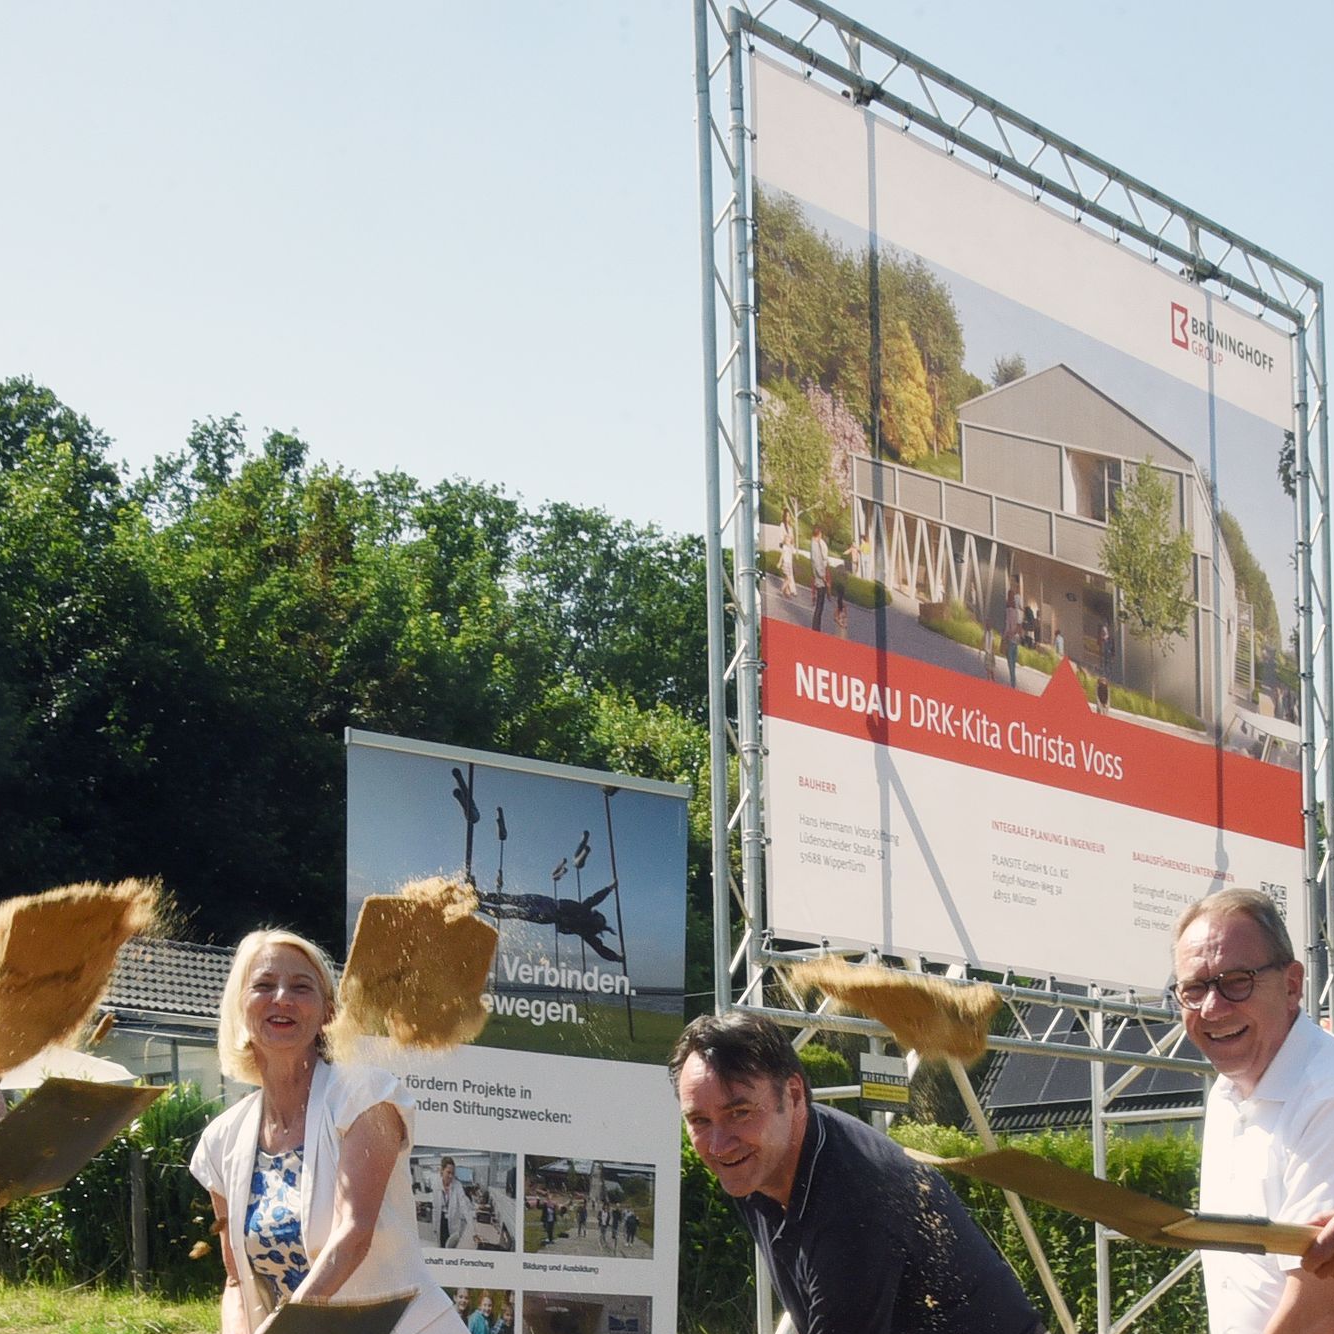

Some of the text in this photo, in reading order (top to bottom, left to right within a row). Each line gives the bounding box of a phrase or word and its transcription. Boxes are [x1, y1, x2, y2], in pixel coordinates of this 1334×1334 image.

[1191, 317, 1274, 373] BRÜNINGHOFF
[1191, 340, 1224, 366] GROUP
[795, 662, 1124, 781] NEUBAU DRK-Kita Christa Voss
[798, 776, 837, 794] BAUHERR
[799, 814, 818, 828] Hans
[820, 818, 853, 835] Hermann
[991, 820, 1106, 854] INTEGRALE PLANUNG & INGENIEUR
[853, 842, 876, 858] Straße
[1023, 860, 1042, 873] GmbH
[502, 955, 636, 996] Verbinden.
[406, 1074, 458, 1092] fördern
[462, 1079, 516, 1099] Projekte
[520, 1085, 532, 1100] in
[453, 1100, 572, 1124] Stiftungszwecken:
[460, 1258, 494, 1269] Forschung
[523, 1262, 547, 1272] Bildung
[563, 1264, 599, 1274] Ausbildung
